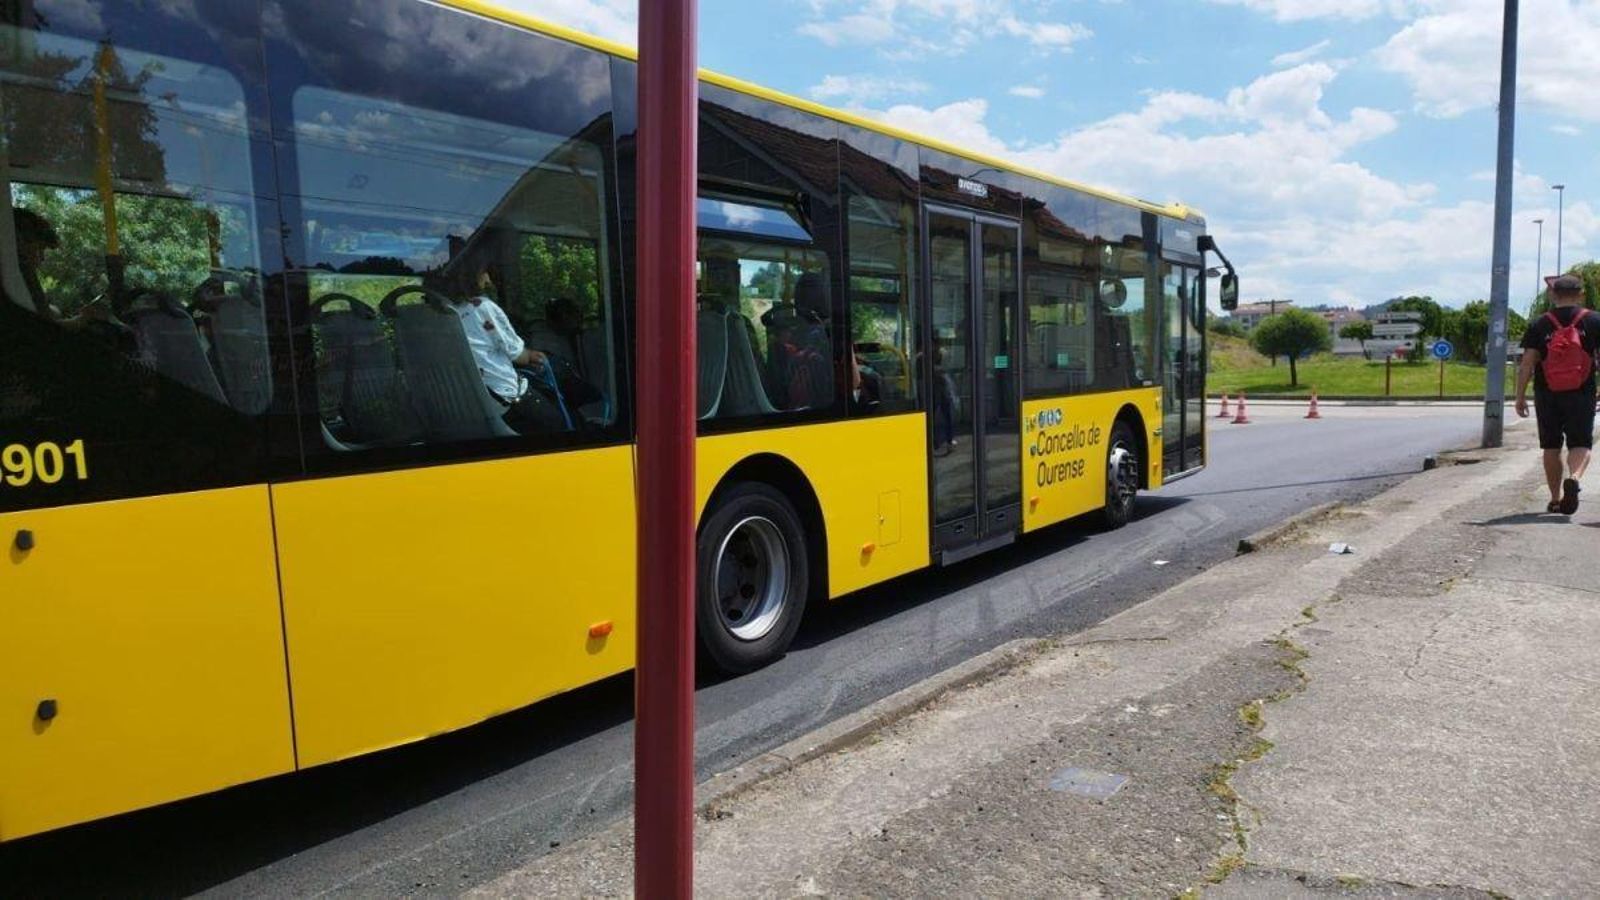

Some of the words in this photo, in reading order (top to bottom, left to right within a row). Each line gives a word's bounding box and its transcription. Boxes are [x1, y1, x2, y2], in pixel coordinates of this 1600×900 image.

[1037, 424, 1086, 456] Concello
[1087, 423, 1101, 445] de
[0, 440, 87, 487] 901
[1037, 459, 1085, 487] Ourense
